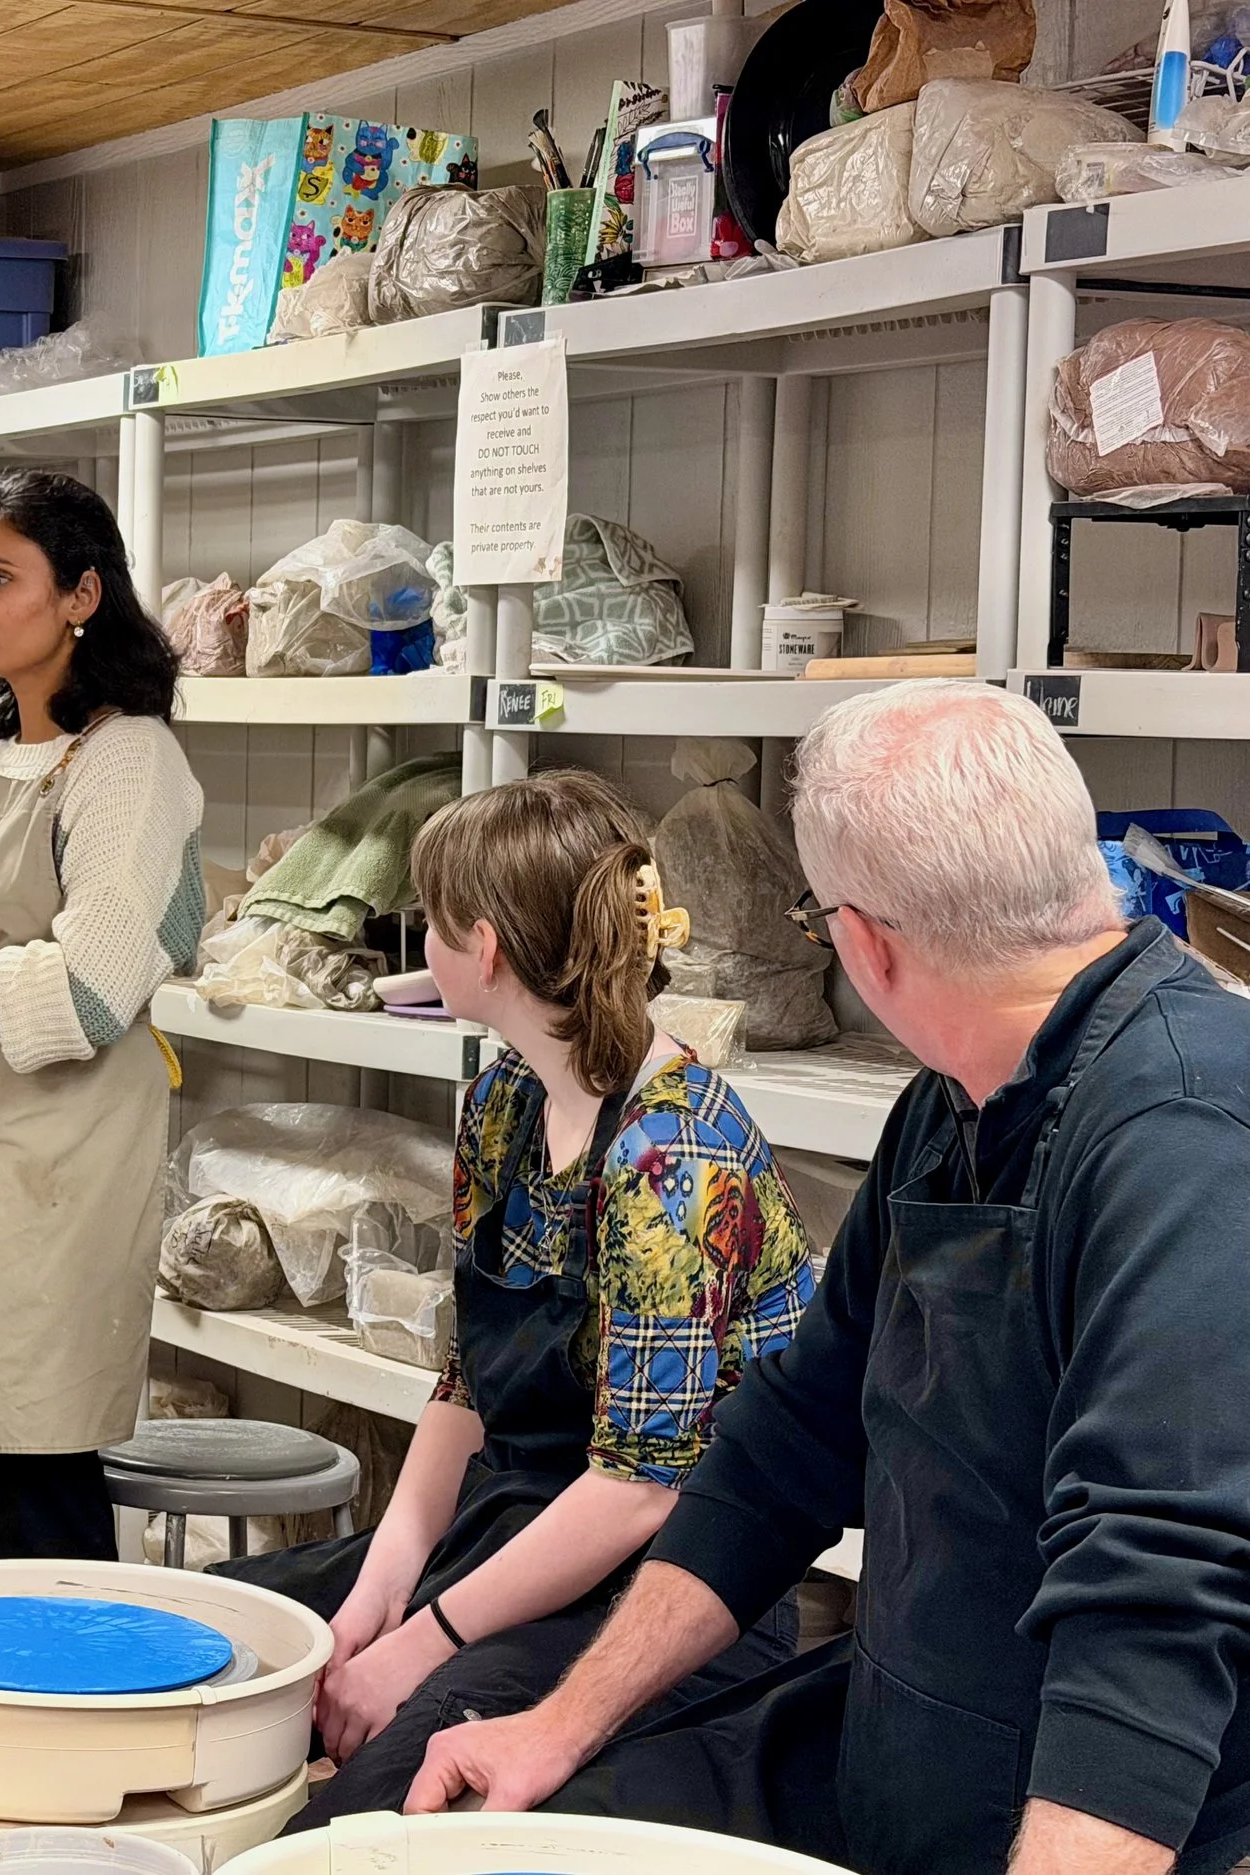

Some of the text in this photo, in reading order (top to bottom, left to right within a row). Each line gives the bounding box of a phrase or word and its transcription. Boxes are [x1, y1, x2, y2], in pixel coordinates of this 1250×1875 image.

[670, 211, 694, 234] Box
[497, 370, 523, 382] Please,
[480, 386, 539, 403] Show others the
[470, 405, 550, 424] respect you'd want to
[486, 424, 532, 440] receive and
[478, 443, 540, 459] DO NOT TOUCH
[470, 462, 547, 480] anything on shelves
[471, 483, 545, 497] that are not yours.
[470, 521, 542, 534] Their contents are
[471, 540, 536, 554] private property.
[778, 643, 815, 655] STONEWARE
[541, 689, 557, 710] FRI
